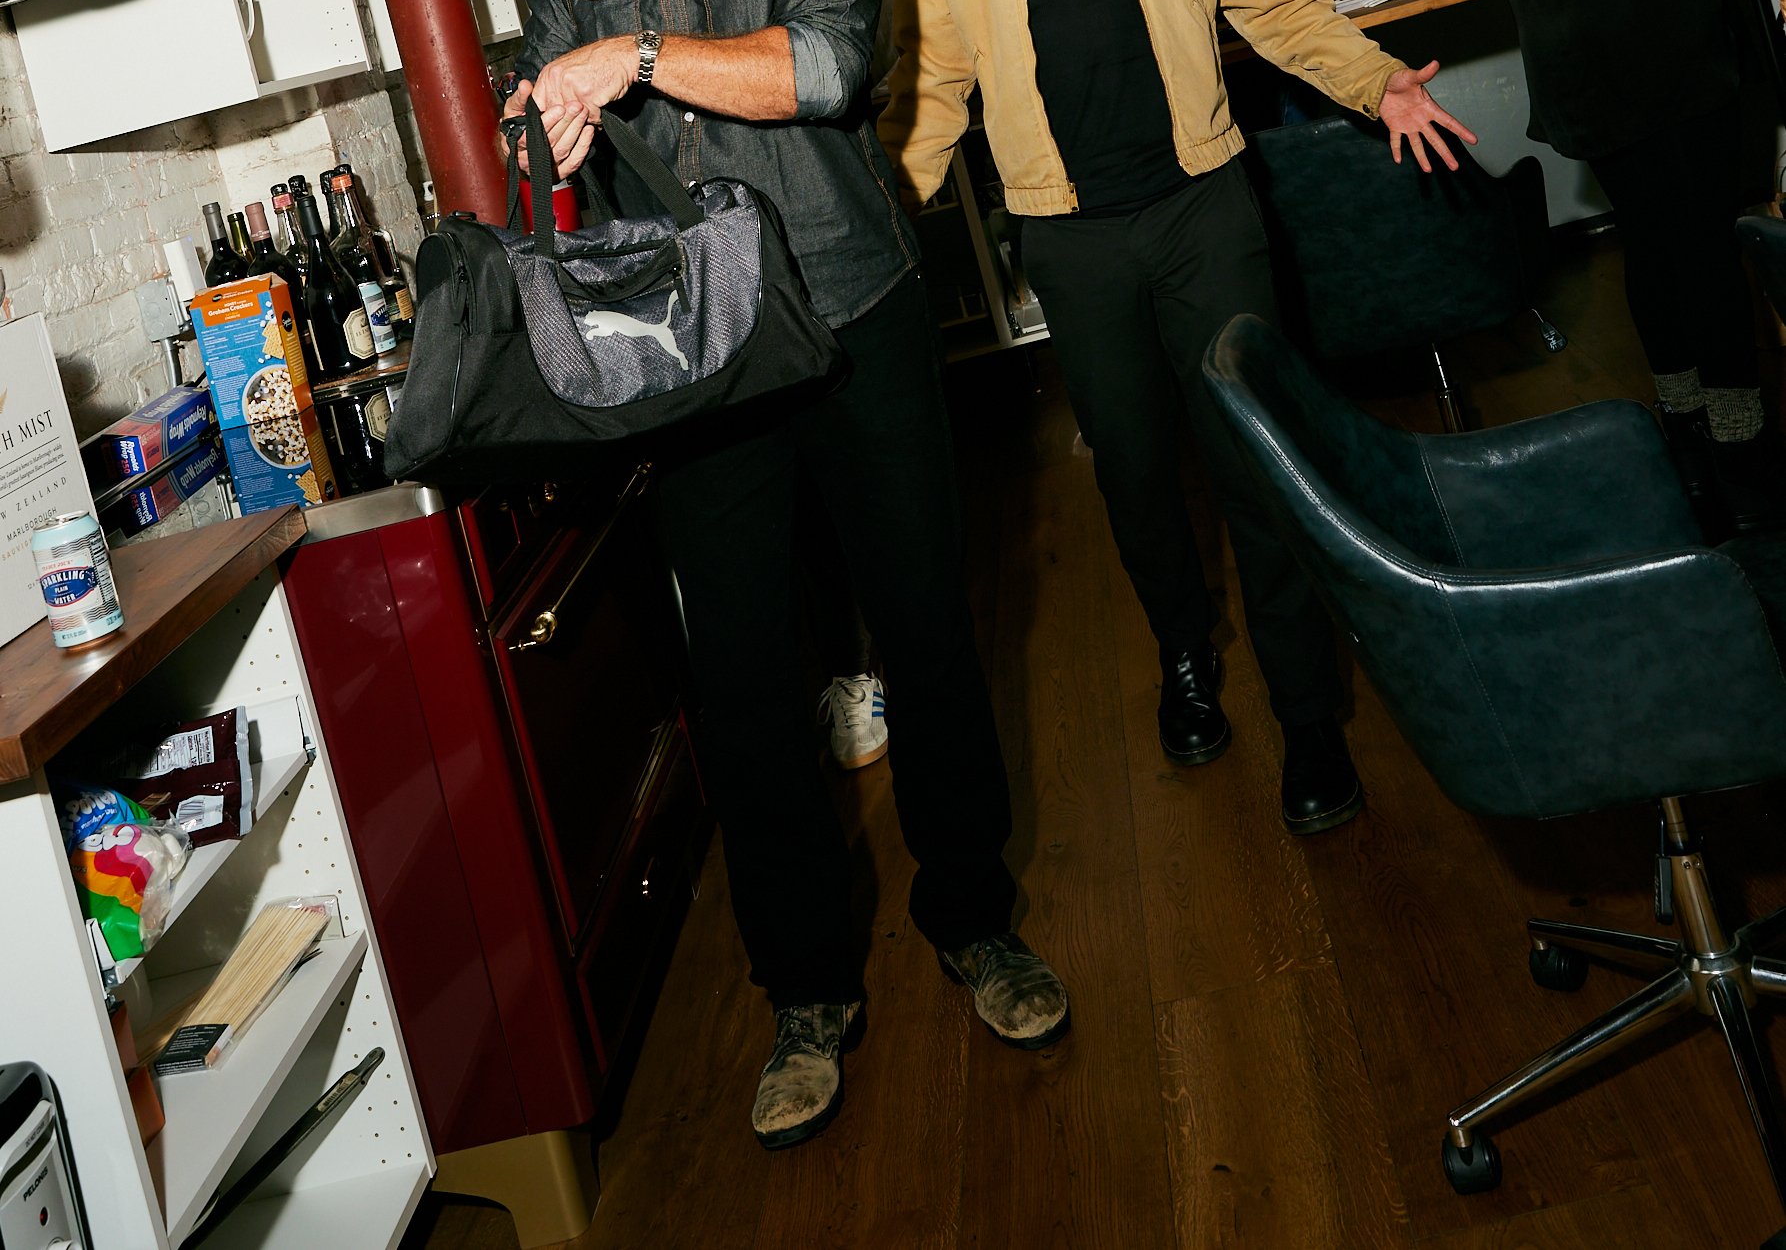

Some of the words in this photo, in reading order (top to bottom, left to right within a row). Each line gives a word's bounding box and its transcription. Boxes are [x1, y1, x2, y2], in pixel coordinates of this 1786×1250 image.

[208, 306, 230, 317] Graham
[229, 301, 254, 312] Crackers
[18, 410, 53, 443] MIST
[183, 406, 207, 430] Reynolds
[169, 422, 186, 440] Wrap
[120, 440, 129, 459] Wrap
[127, 440, 140, 472] Reynolds
[121, 459, 131, 474] 250
[16, 476, 67, 513] ZEALAND
[6, 506, 58, 542] MARLBOROUGH
[41, 570, 85, 589] SPARKLING
[54, 585, 69, 594] PLAIN
[53, 594, 76, 605] WATER
[23, 1166, 48, 1202] PELONIS
